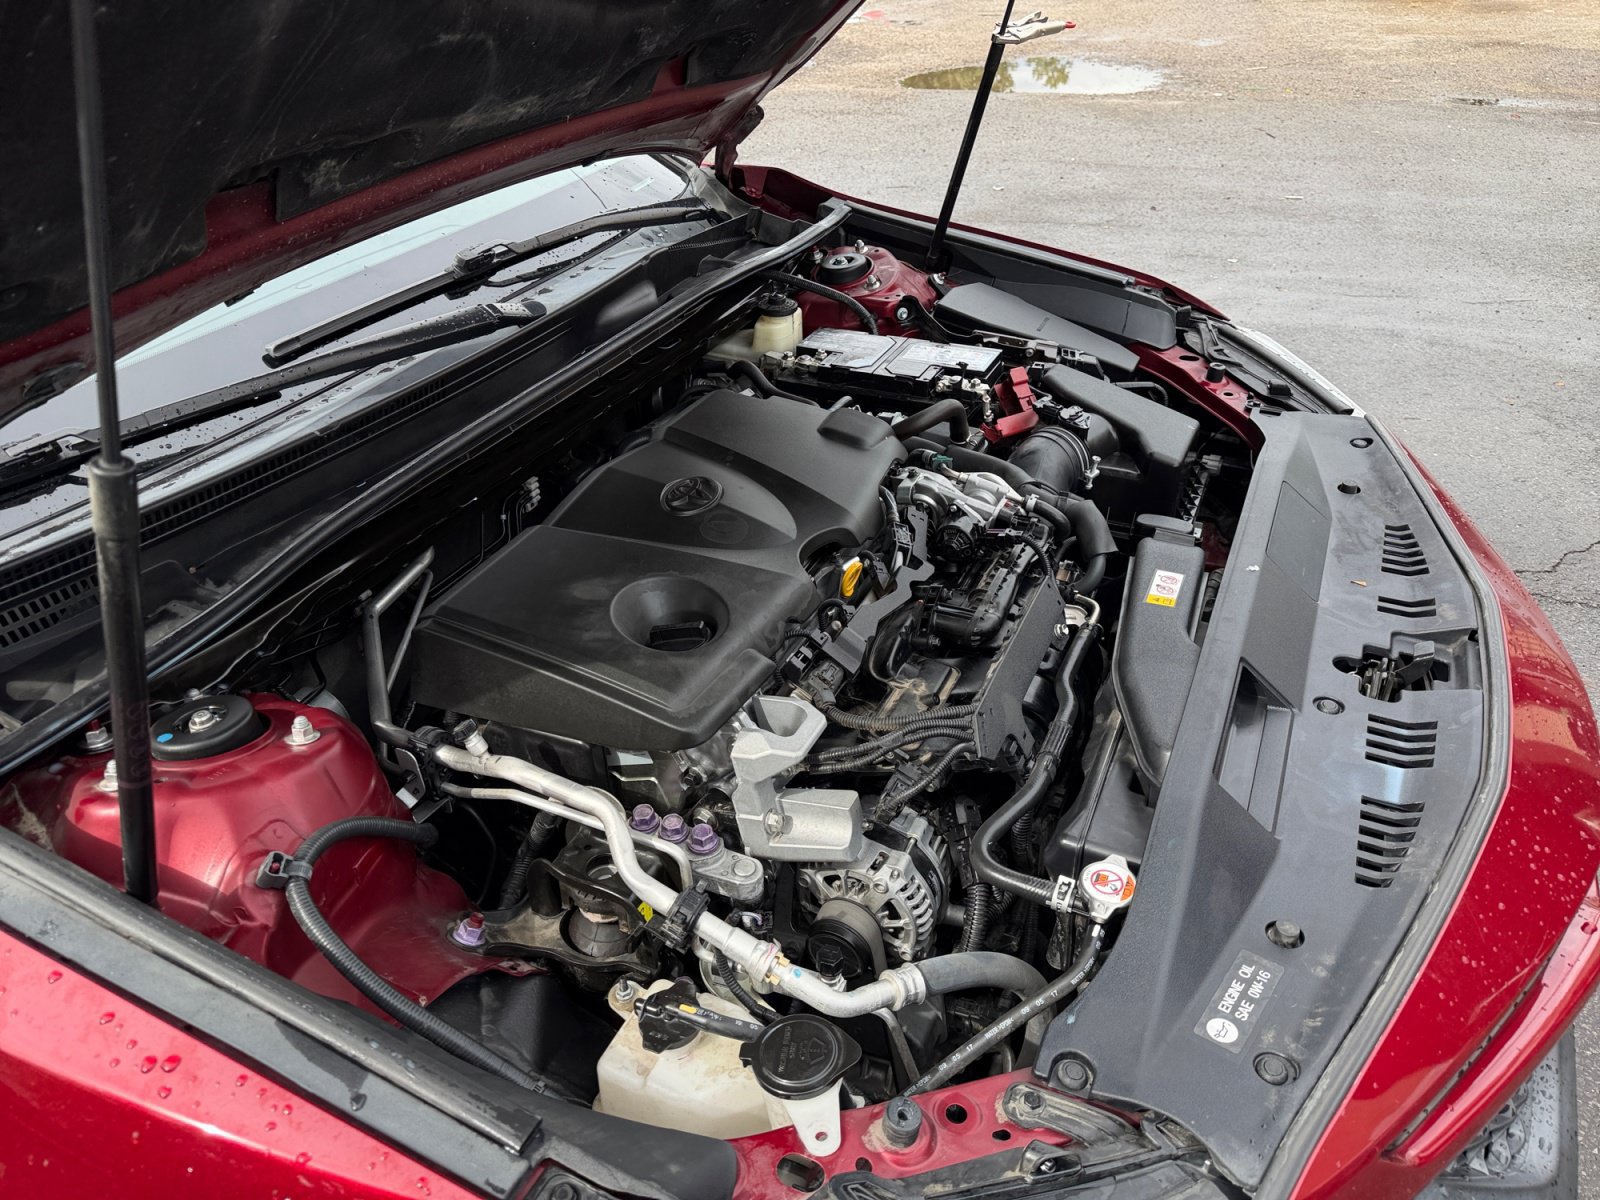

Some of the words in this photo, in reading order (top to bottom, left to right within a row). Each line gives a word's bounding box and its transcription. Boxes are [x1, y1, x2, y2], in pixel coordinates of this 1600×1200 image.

[1035, 998, 1045, 1007] 05
[1050, 989, 1058, 998] 17
[1217, 978, 1245, 1014] ENGINE
[1238, 964, 1256, 979] OIL
[1234, 999, 1255, 1021] SAE
[1247, 970, 1271, 999] 0W-16
[966, 1043, 974, 1052] 17
